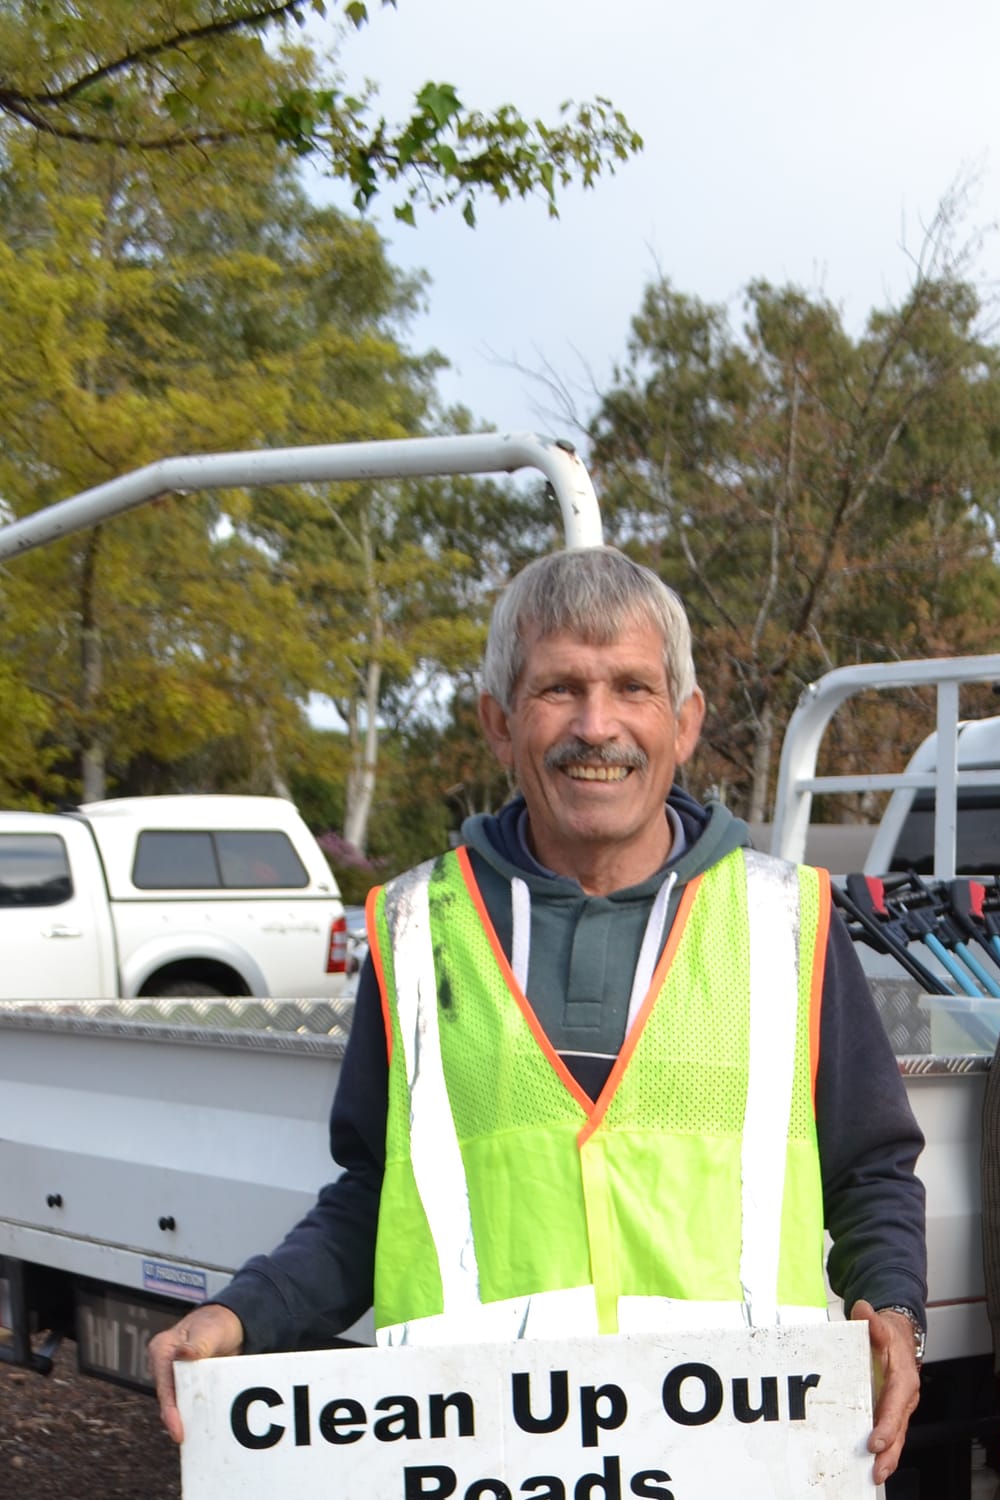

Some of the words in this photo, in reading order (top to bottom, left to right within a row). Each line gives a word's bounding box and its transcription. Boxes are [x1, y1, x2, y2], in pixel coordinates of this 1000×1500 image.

[231, 1386, 474, 1449] Clean
[512, 1371, 627, 1447] Up
[663, 1363, 820, 1425] Our
